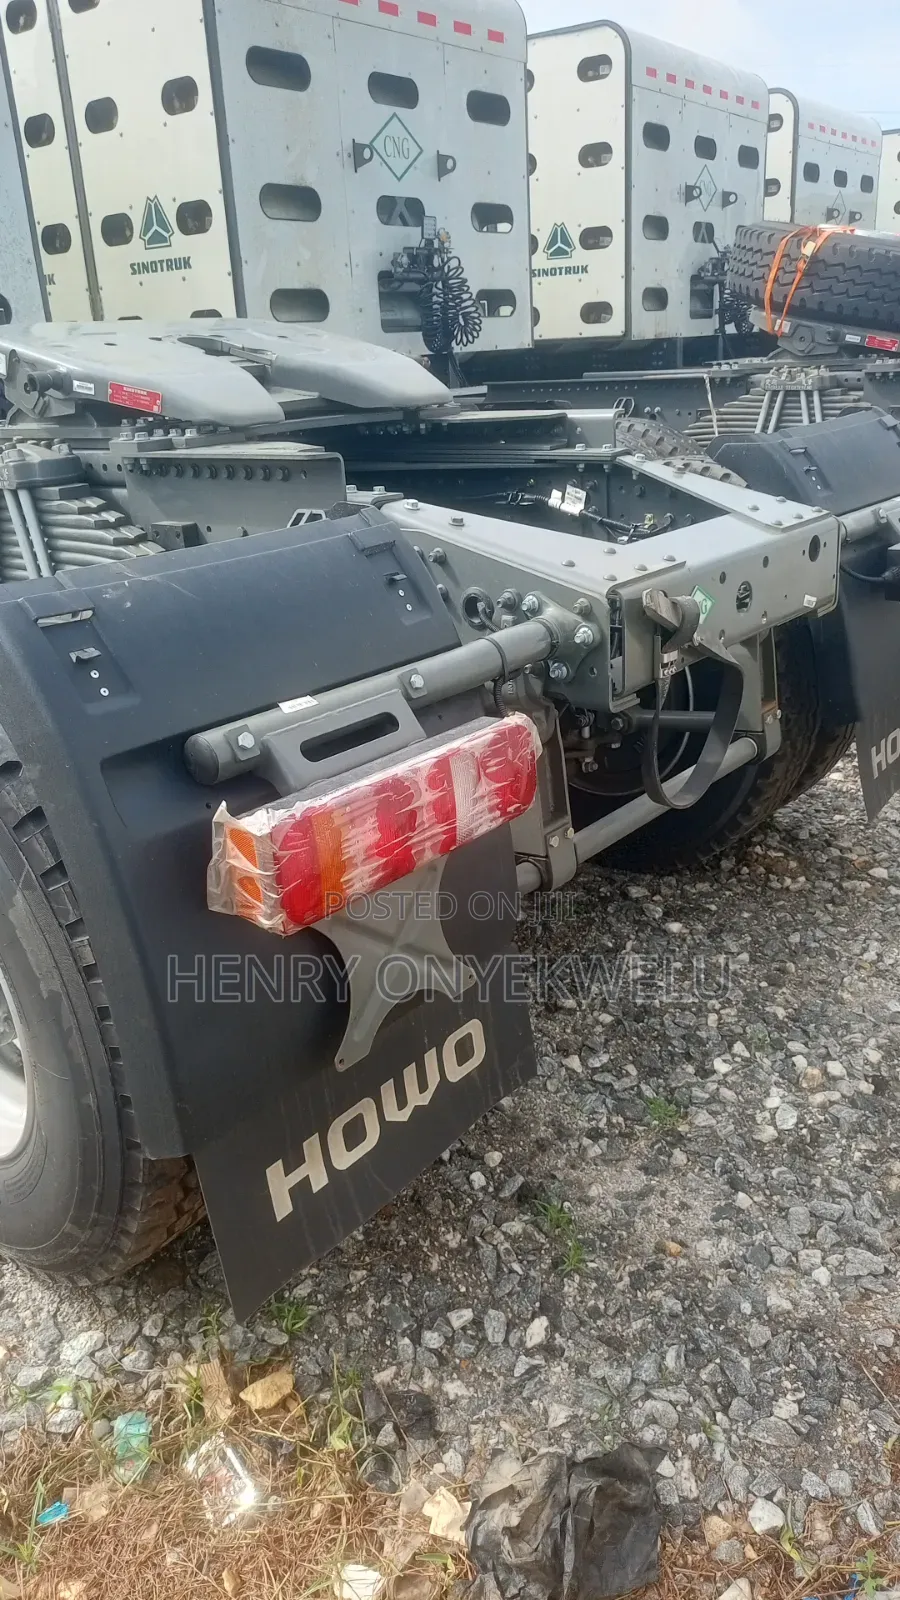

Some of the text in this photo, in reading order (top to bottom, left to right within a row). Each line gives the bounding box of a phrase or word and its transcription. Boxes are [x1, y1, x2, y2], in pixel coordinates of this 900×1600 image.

[384, 135, 409, 159] CNG
[130, 256, 192, 275] SINOTRUK
[532, 265, 589, 278] SINOTRUK
[871, 728, 900, 780] HO
[266, 1018, 486, 1222] HOWO
